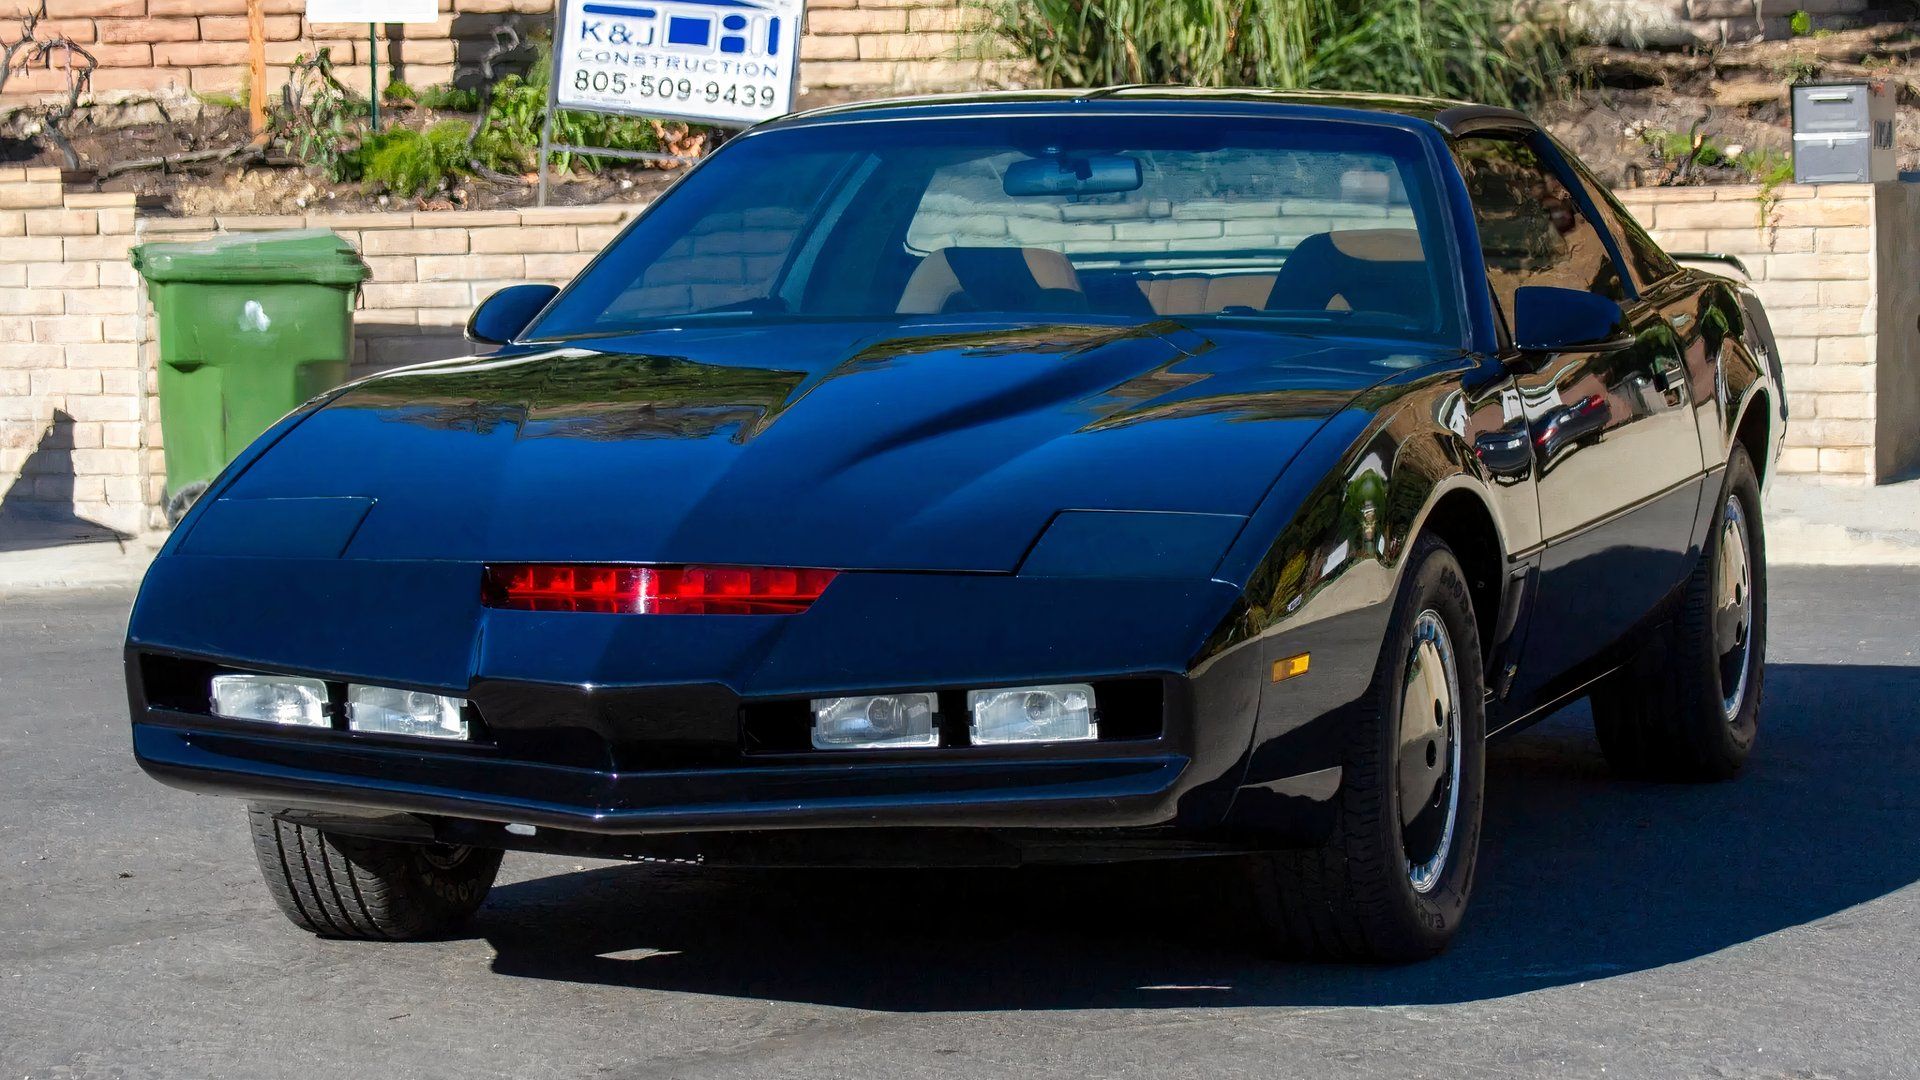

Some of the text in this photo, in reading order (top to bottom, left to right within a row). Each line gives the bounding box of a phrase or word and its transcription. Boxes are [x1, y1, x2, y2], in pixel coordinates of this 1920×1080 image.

[581, 21, 654, 47] K&J
[577, 49, 778, 78] CONSTRUCTION
[574, 69, 776, 109] 805-509-9439
